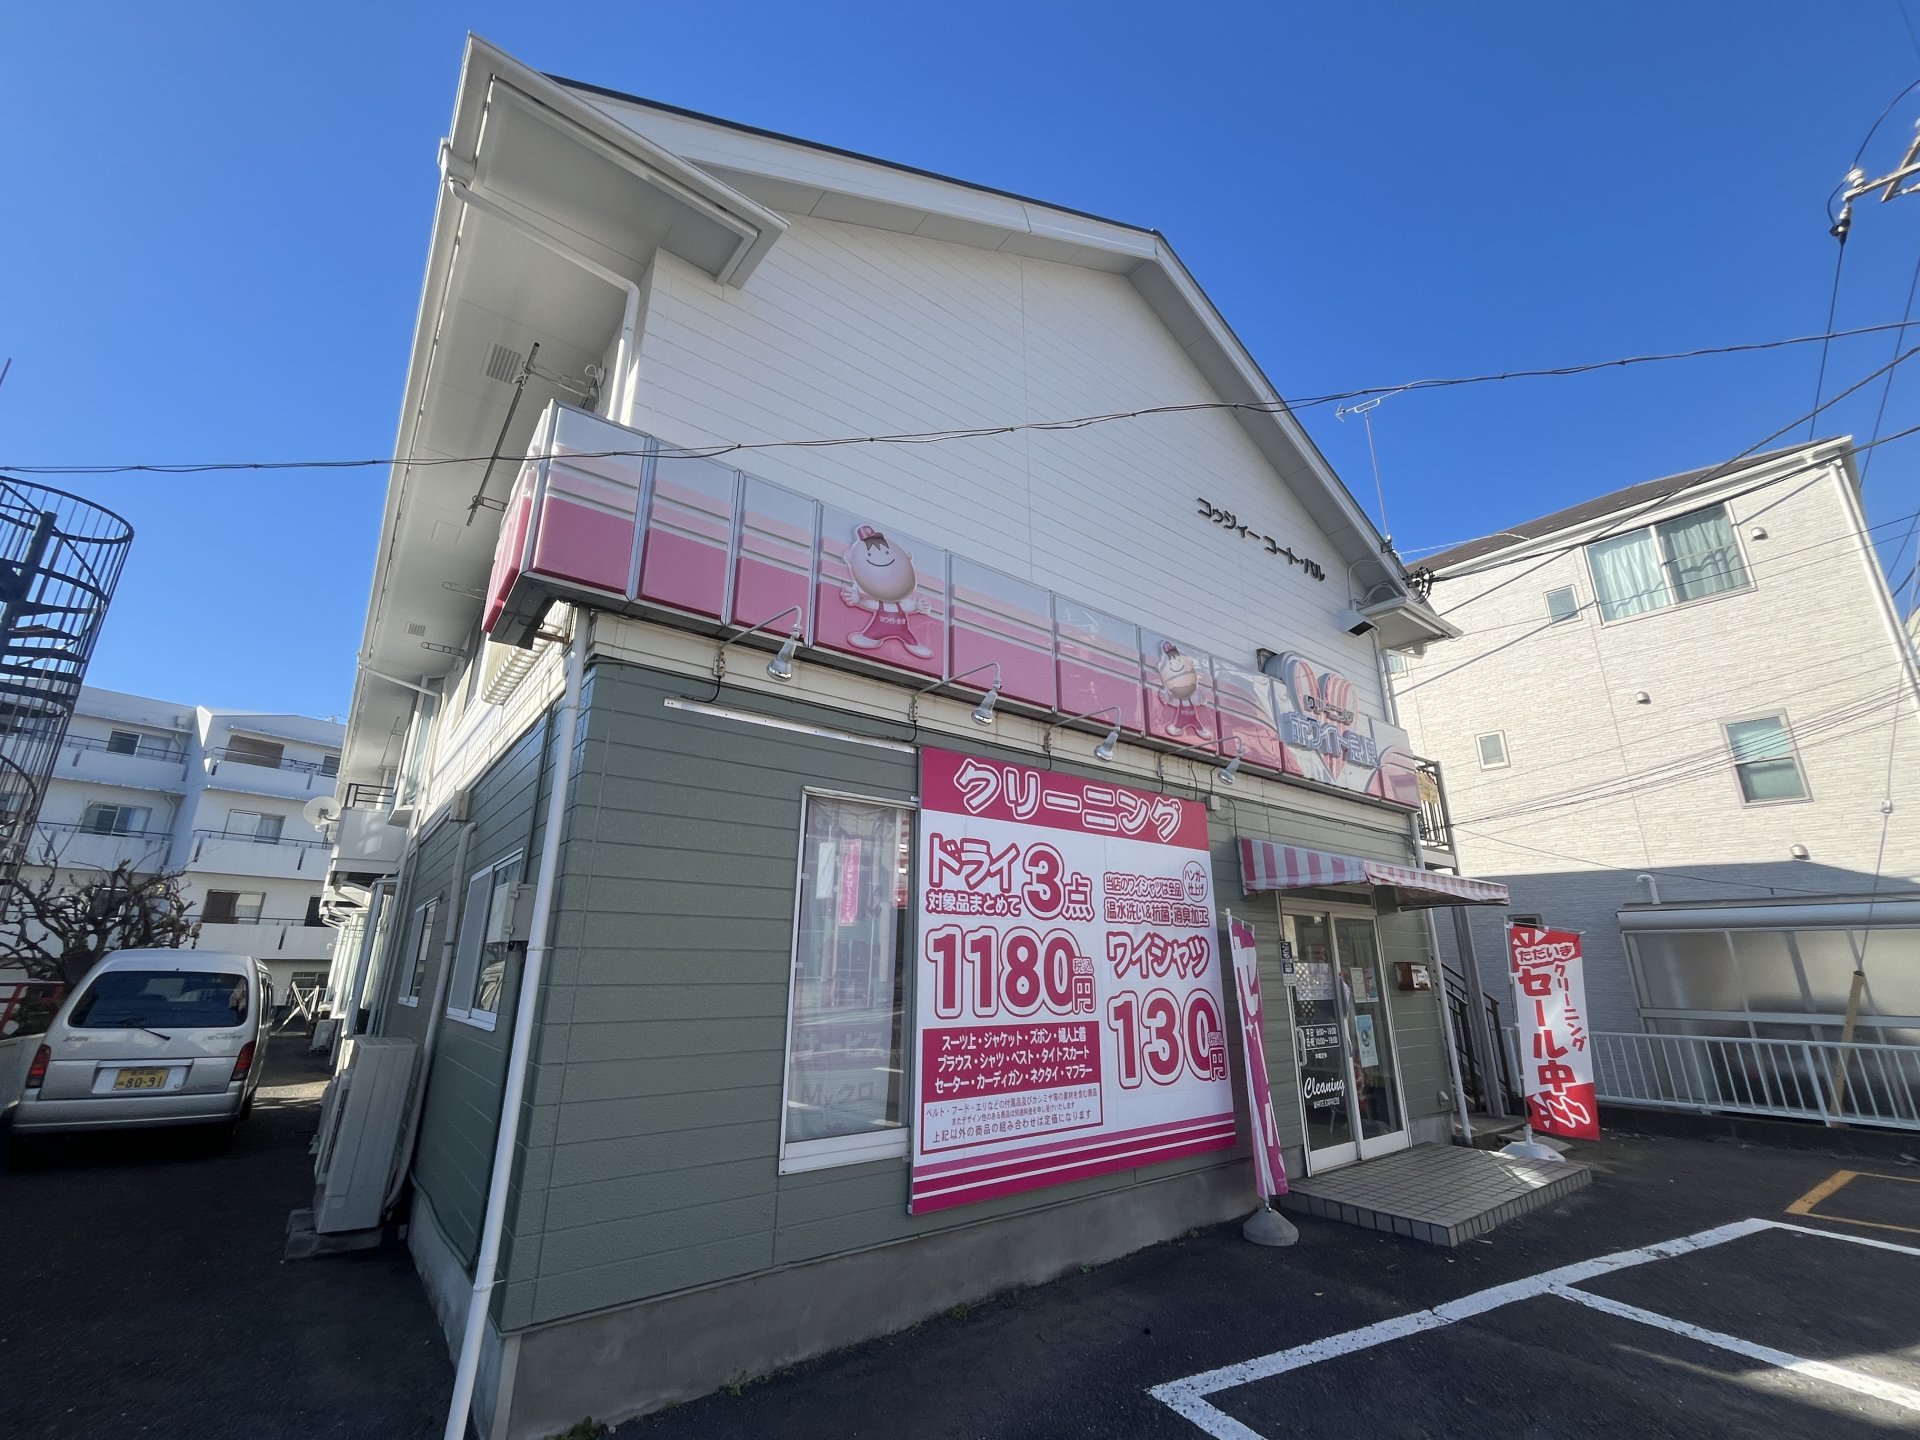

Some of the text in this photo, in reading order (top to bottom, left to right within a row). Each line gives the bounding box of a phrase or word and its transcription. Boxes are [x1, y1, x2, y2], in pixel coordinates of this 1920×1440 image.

[953, 757, 1182, 843] クリーニング
[928, 832, 1021, 894] ドライ
[1184, 869, 1206, 883] ハンガー
[1103, 871, 1184, 900] 当店のワイシャツは全品
[1188, 883, 1205, 897] 仕上げ
[926, 889, 1022, 918] 対象品まとめて
[1105, 930, 1211, 981] ワイシャツ
[1516, 942, 1576, 965] ただいま
[1554, 963, 1588, 1052] クリーニング
[1517, 967, 1577, 1094] セール中
[1304, 1077, 1345, 1099] Cleaning
